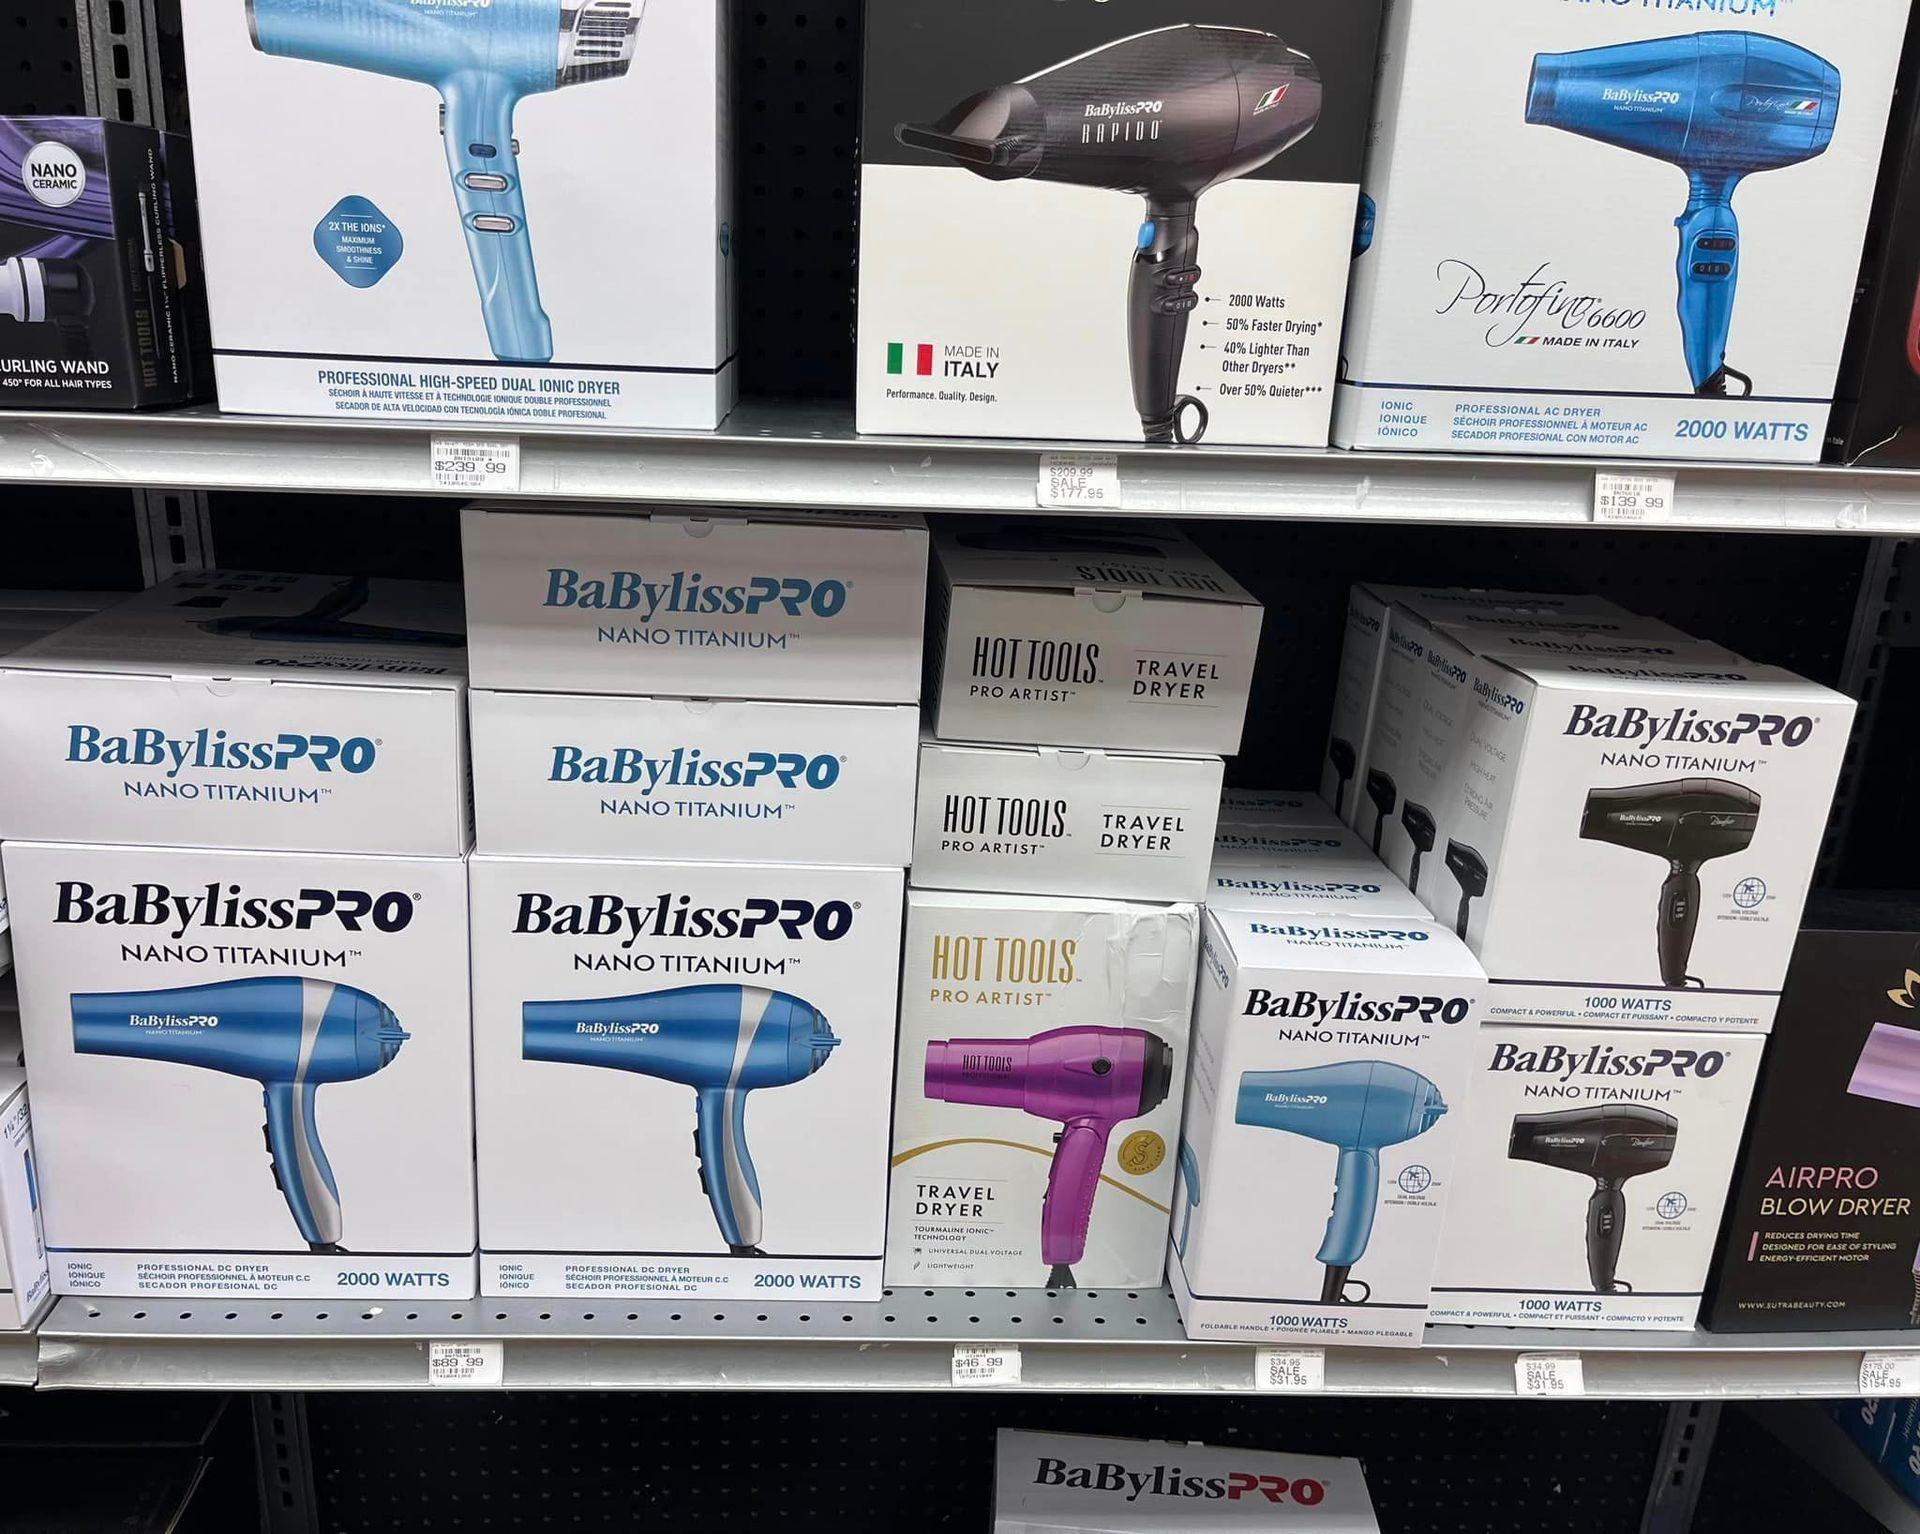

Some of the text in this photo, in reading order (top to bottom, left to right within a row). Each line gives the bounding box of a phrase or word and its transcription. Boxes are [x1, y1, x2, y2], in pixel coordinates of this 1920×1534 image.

[31, 164, 77, 178] NANO
[33, 180, 77, 189] CERAMIC
[328, 222, 339, 230] 2X
[341, 222, 358, 231] THE
[341, 236, 375, 244] MAXIMUM
[336, 245, 382, 254] SMOOTHNESS
[353, 256, 373, 264] SHINE
[1229, 294, 1285, 308] 2000 Watts
[1226, 318, 1249, 330] 50%
[1252, 319, 1283, 332] Faster
[1587, 308, 1646, 329] 6600
[1224, 342, 1310, 357] 40% Lighter Than
[1542, 337, 1640, 349] MADE IN ITALY
[944, 345, 999, 358] MADE IN
[61, 360, 109, 374] WAND
[944, 360, 999, 378] ITALY
[1222, 360, 1249, 373] Other
[24, 379, 41, 387] FOR
[43, 379, 61, 388] ALL
[62, 380, 82, 388] HAIR
[84, 380, 112, 389] TYPES
[318, 370, 621, 396] PROFESSIONAL HIGH-SPEED DUAL IONIC DRYER
[1220, 383, 1242, 395] Over
[1244, 384, 1266, 396] 50%
[886, 389, 997, 404] Performance. Quality. Design.
[1381, 401, 1413, 411] IONIC
[1455, 404, 1601, 417] PROFESSIONAL AC DRYER
[1379, 414, 1427, 424] IONIQUE
[1675, 419, 1727, 439] 2000
[1734, 421, 1809, 442] WATTS
[1050, 467, 1093, 477] $209.99
[1050, 478, 1086, 488] SALE
[1050, 488, 1103, 499] $177.95
[597, 627, 670, 645] NANO
[971, 635, 1022, 680] HOT
[1135, 659, 1220, 681] TRAVEL
[969, 685, 1004, 698] PRO
[1133, 681, 1206, 700] DRYER
[1600, 752, 1660, 769] NANO
[123, 781, 199, 799] NANO
[121, 943, 209, 964] NANO
[932, 934, 988, 982] HOT
[573, 953, 655, 973] NANO
[930, 989, 969, 1004] PRO
[1584, 996, 1672, 1011] 1000 WATTS
[1490, 1007, 1527, 1015] COMPACT
[1535, 1009, 1576, 1017] POWERFUL
[1583, 1011, 1619, 1019] COMPACT
[1631, 1013, 1669, 1021] PUISSANT
[1675, 1015, 1717, 1023] COMPACTO
[1725, 1017, 1759, 1025] POTENTE
[1279, 1029, 1333, 1043] NANO
[1765, 1166, 1878, 1189] AIRPRO
[916, 1184, 995, 1201] TRAVEL
[915, 1202, 984, 1217] DRYER
[1760, 1198, 1911, 1216] BLOW DRYER
[914, 1226, 964, 1234] TOURMALINE
[1839, 1254, 1870, 1262] MOTOR
[137, 1264, 214, 1272] PROFESSIONAL
[337, 1272, 450, 1287] 2000 WATTS
[1739, 1301, 1845, 1310] WWW.SUTRABEAUTY.COM
[1270, 1316, 1348, 1328] 1000 WATTS
[1270, 1366, 1300, 1376] SALE
[1527, 1371, 1556, 1380] SALE
[1863, 1370, 1889, 1380] SALE
[1270, 1375, 1307, 1385] $31.95
[1527, 1380, 1564, 1390] $31.95
